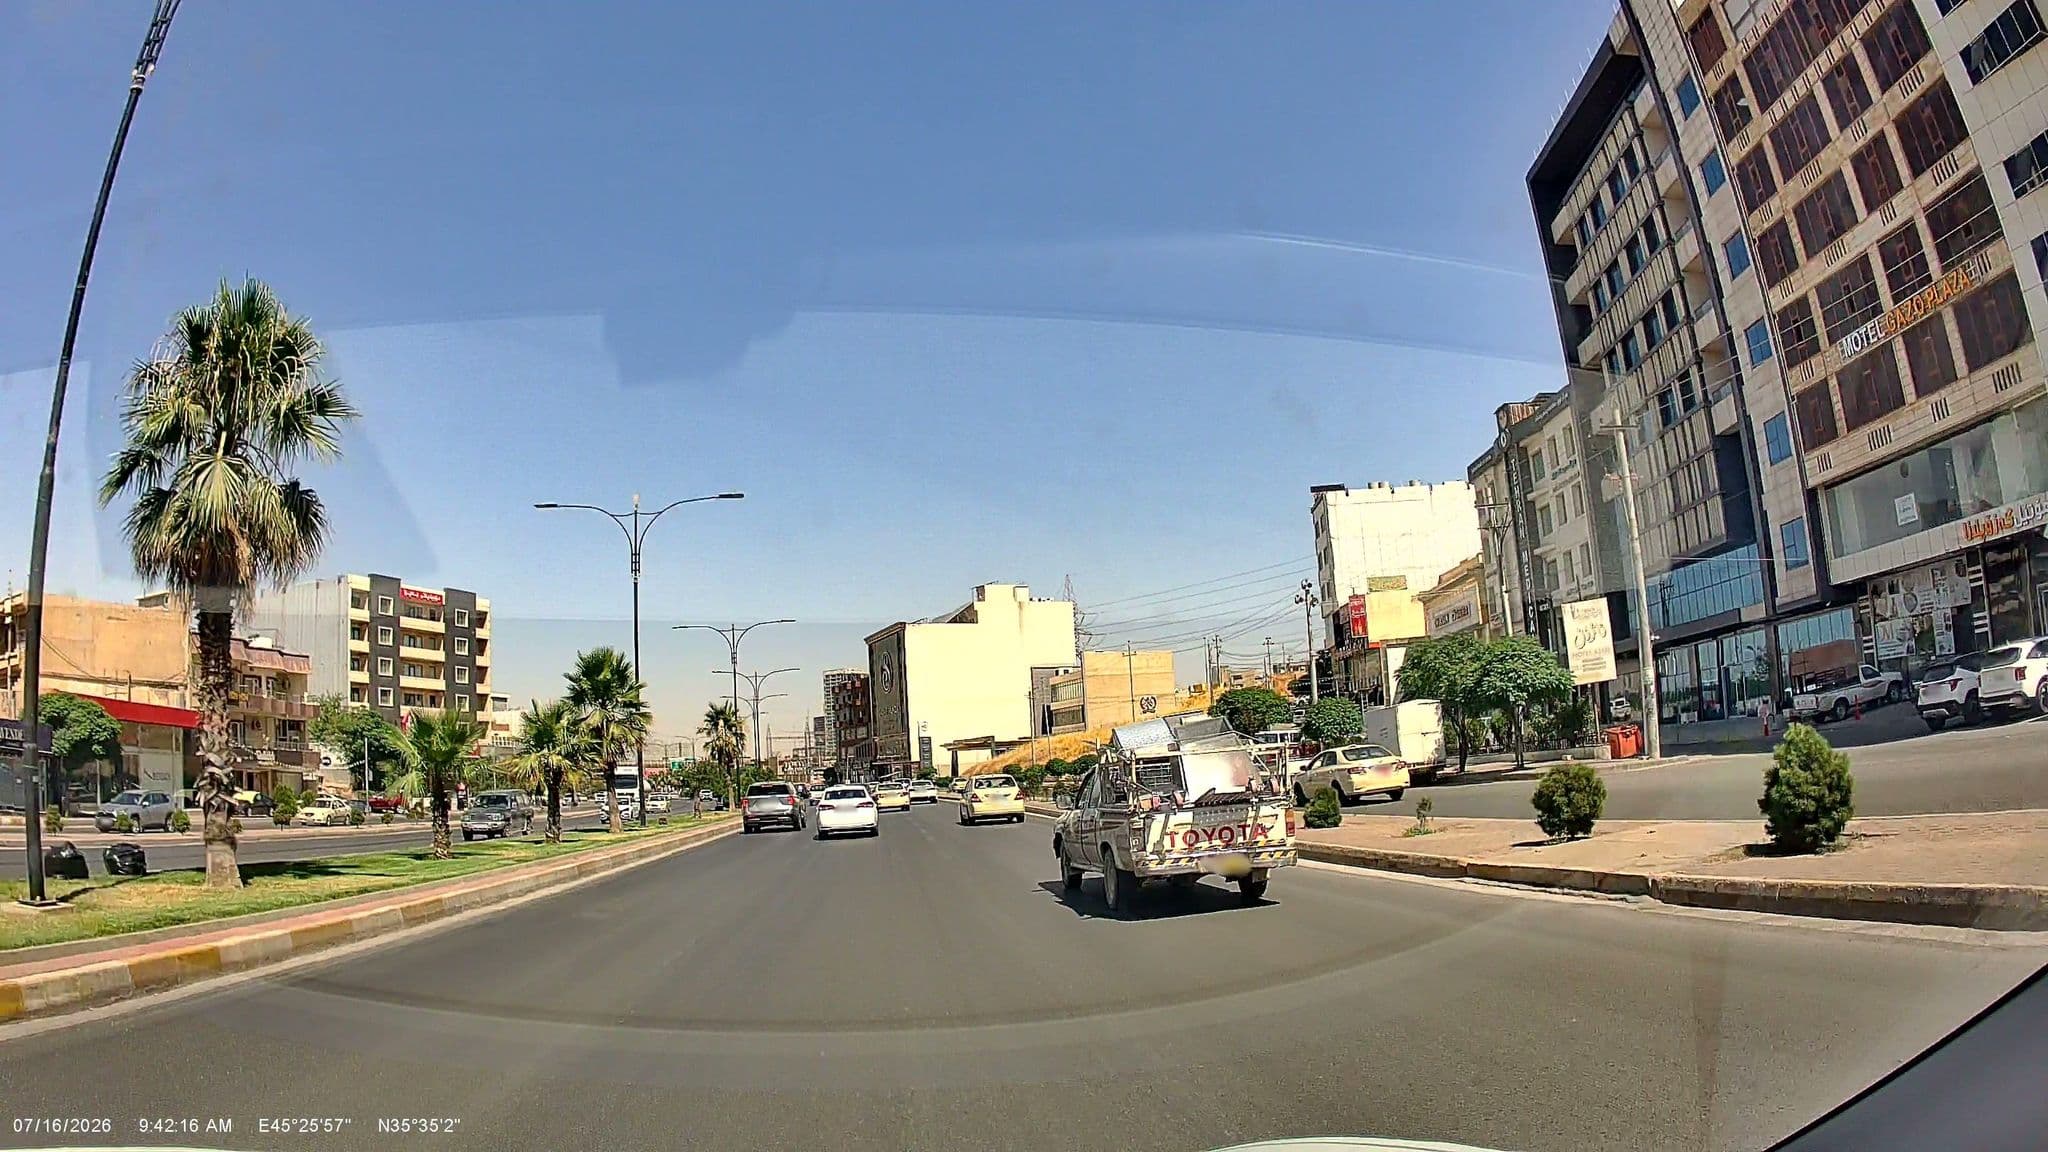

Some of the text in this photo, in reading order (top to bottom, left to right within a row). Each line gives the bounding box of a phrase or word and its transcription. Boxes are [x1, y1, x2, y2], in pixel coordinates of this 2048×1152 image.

[1842, 267, 1971, 358] MOTEL GAZO PLAZA
[1521, 549, 1537, 637] MEDICA
[1165, 823, 1269, 849] TOYOTA
